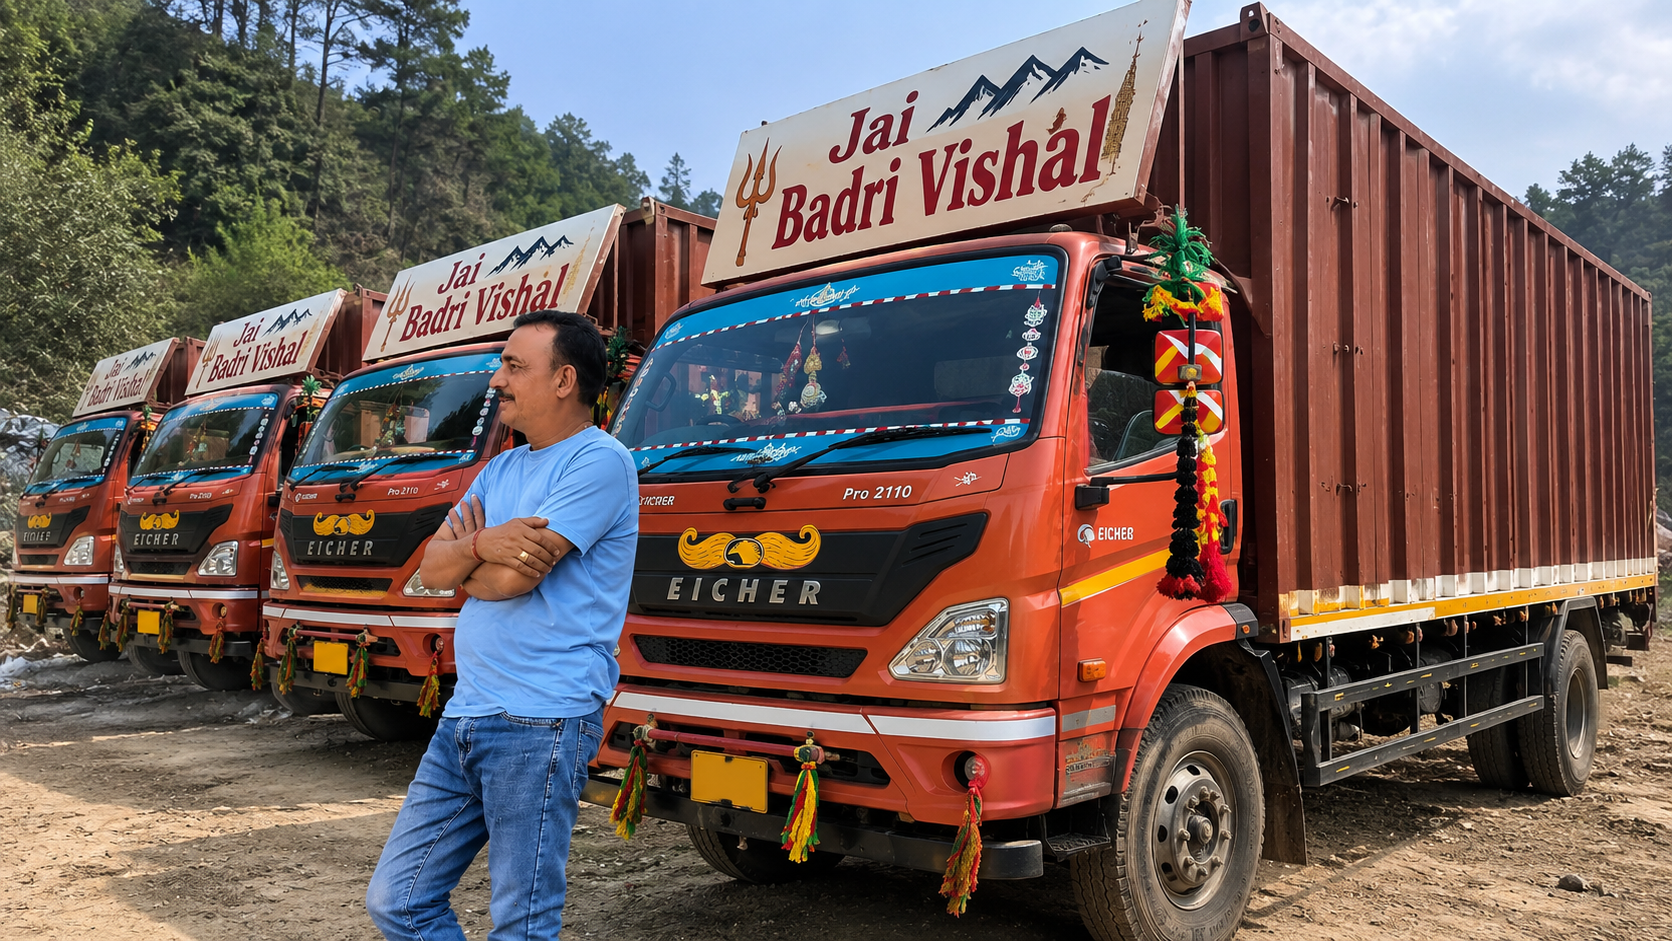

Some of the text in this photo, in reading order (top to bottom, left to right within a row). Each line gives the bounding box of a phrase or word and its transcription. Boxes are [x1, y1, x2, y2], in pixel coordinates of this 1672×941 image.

[828, 90, 919, 164] Jai
[771, 95, 1112, 250] Badri Vishal
[437, 252, 486, 294] Jai
[399, 263, 570, 342] Badri Vishal
[233, 317, 265, 347] Jai
[207, 329, 308, 383] Badri Vishal
[843, 485, 912, 500] Pro 2110
[133, 533, 180, 546] EICHER
[306, 540, 375, 556] EICHER
[667, 577, 822, 605] EICHER
